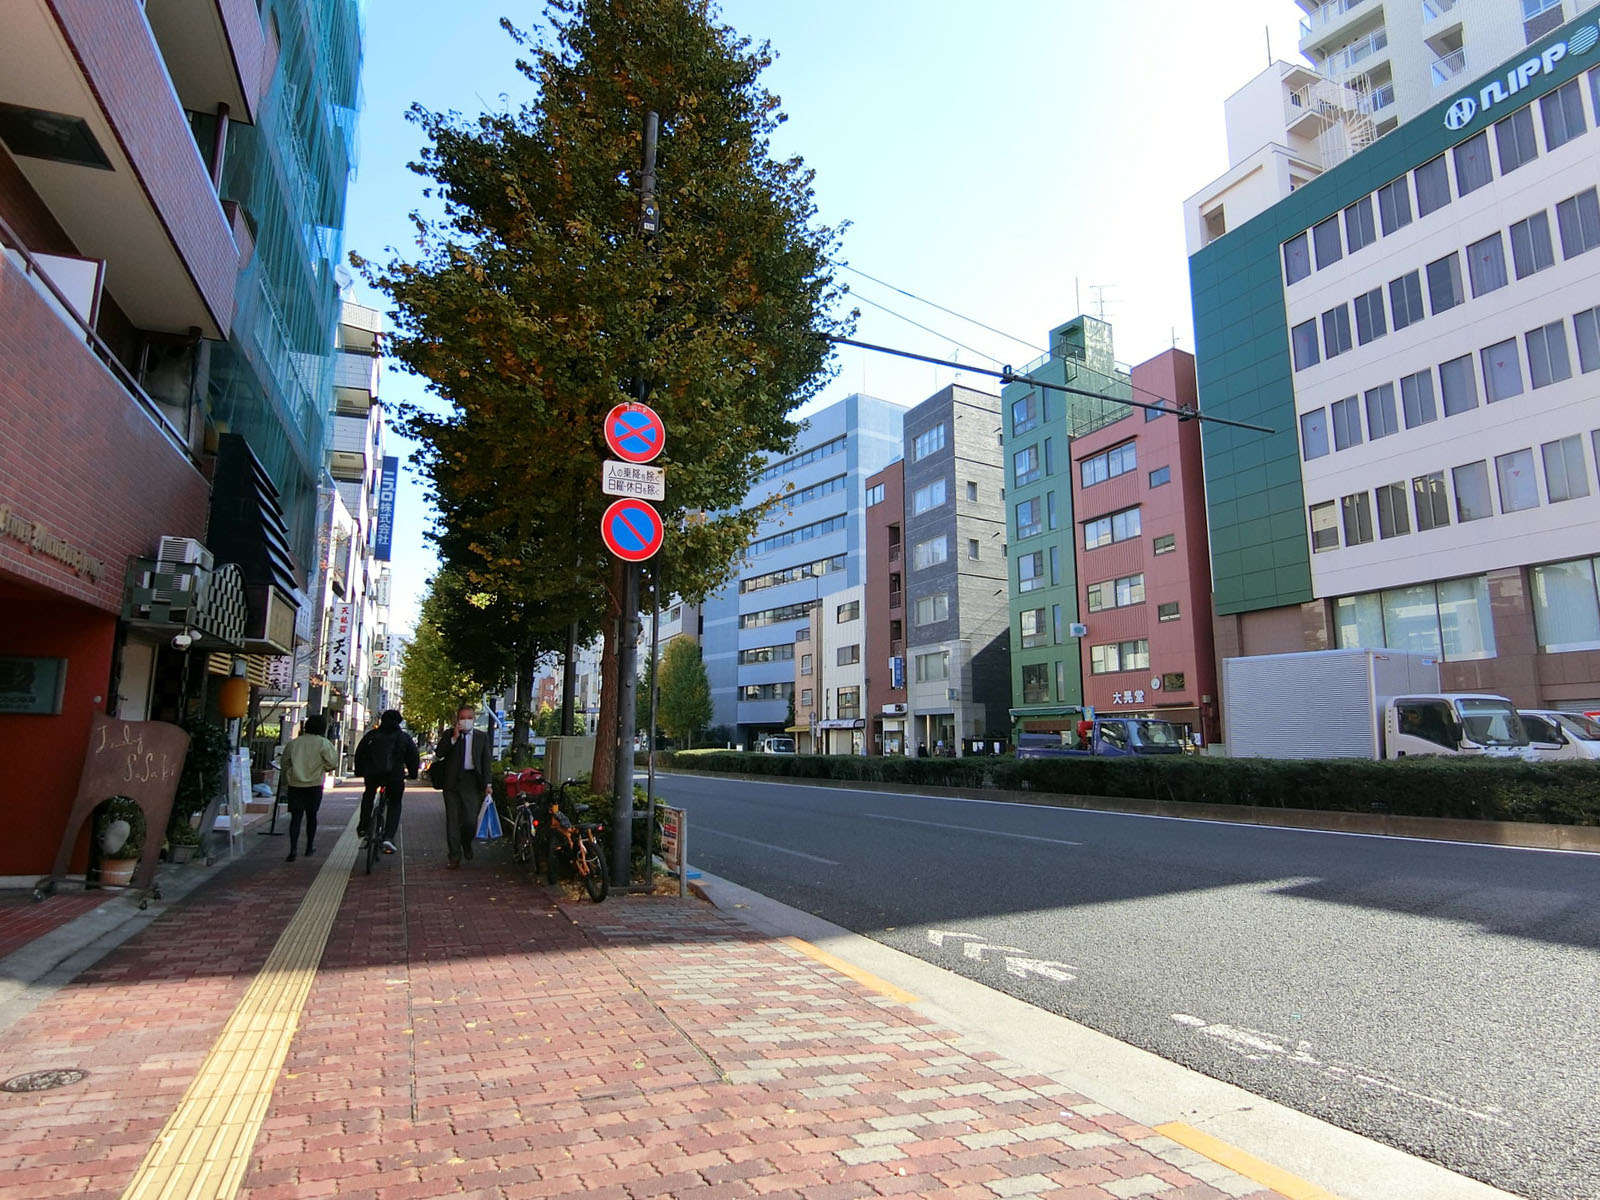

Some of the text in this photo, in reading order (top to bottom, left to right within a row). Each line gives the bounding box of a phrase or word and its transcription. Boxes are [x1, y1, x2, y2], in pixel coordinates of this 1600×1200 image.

[608, 465, 660, 482] 人の乗降を除く
[377, 471, 395, 545] ニプロ株式会社
